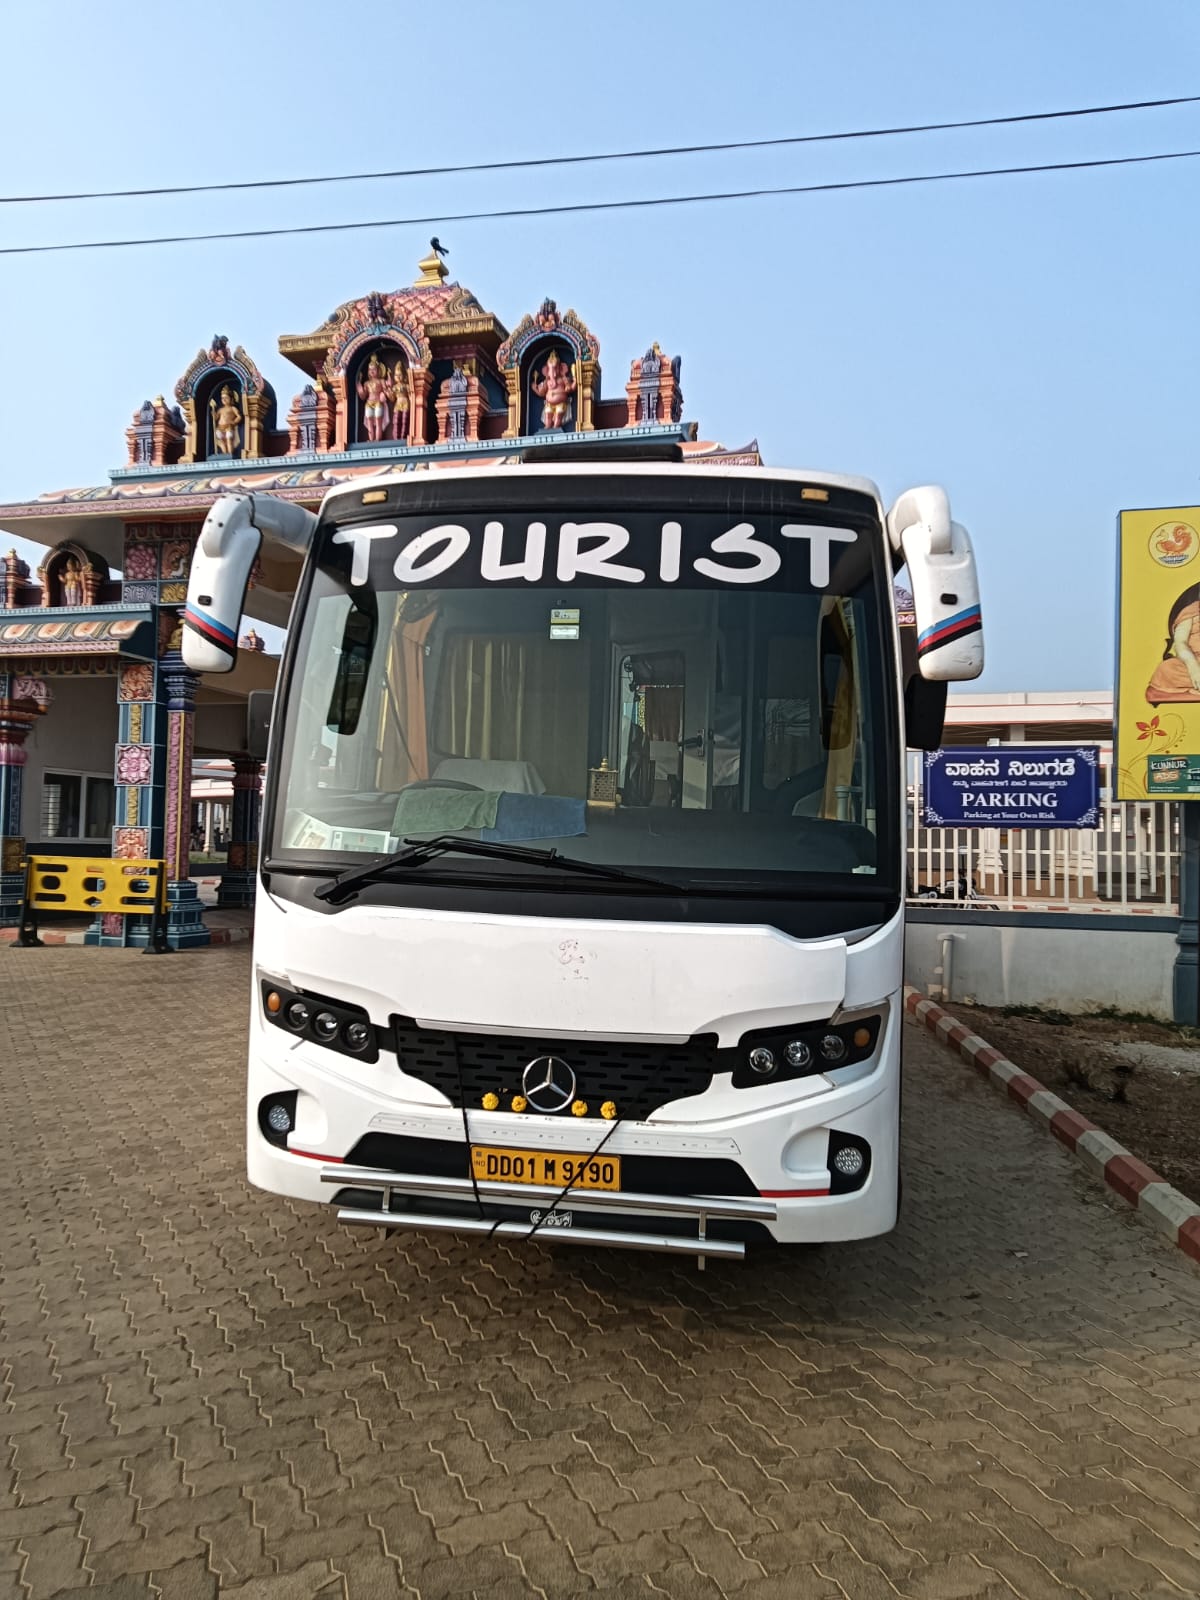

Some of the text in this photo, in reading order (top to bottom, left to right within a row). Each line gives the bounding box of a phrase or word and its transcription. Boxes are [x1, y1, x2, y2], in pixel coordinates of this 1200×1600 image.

[331, 521, 858, 588] TOURIST
[945, 758, 1075, 776] ವಾಹನ ನಿಲುಗಡೆ
[961, 792, 1058, 808] PARKING
[963, 811, 993, 820] Parking
[1001, 811, 1019, 819] Your
[1019, 811, 1038, 819] Own
[1038, 811, 1056, 819] Risk
[487, 1154, 614, 1184] DD01 M 9190
